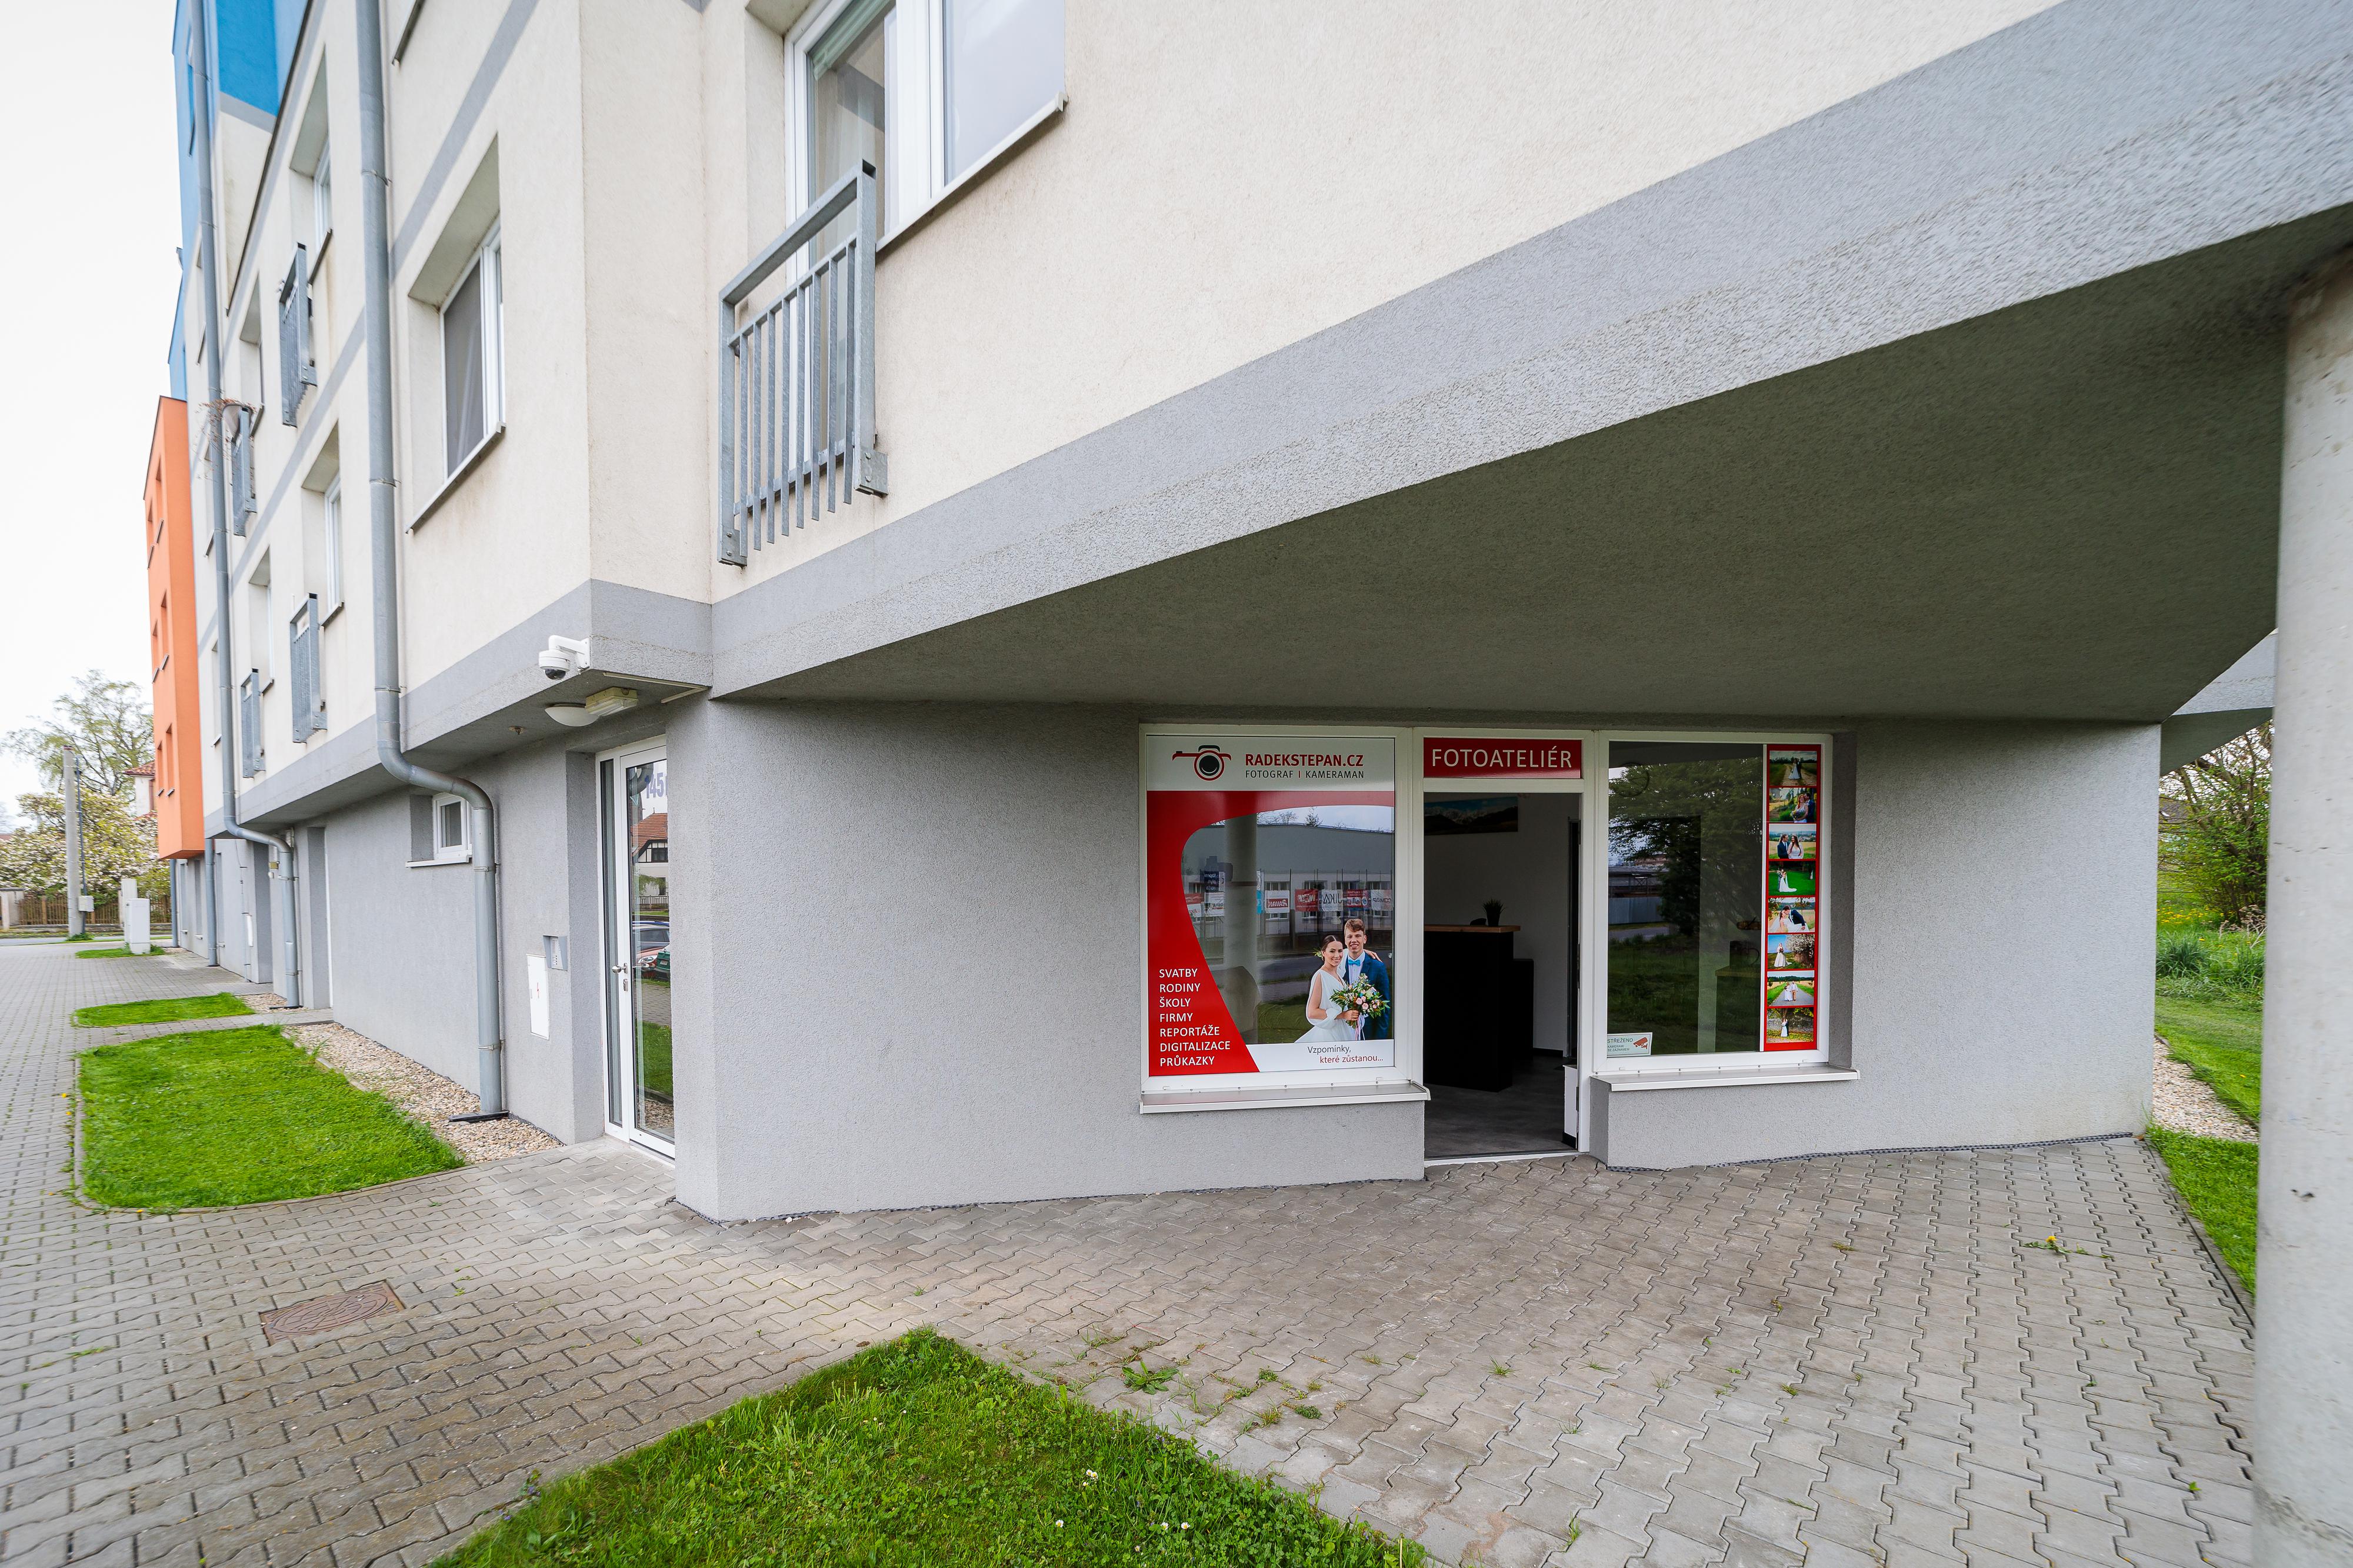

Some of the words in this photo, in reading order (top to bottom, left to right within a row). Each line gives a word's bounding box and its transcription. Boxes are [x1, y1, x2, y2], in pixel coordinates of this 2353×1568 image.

[1245, 753, 1364, 766] RADEKSTEPAN.CZ
[1432, 745, 1572, 768] FOTOATELIÉR
[1245, 770, 1294, 778] FOTOGRAF
[1305, 770, 1364, 779] KAMERAMAN
[1159, 968, 1198, 978] SVATBY
[1159, 983, 1201, 993] RODINY
[1159, 996, 1191, 1007] ŠKOLY
[1160, 1013, 1193, 1022] FIRMY
[1160, 1025, 1219, 1037] REPORTÁŽE
[1160, 1041, 1231, 1052] DIGITALIZACE
[1308, 1045, 1351, 1055] Vzpomínky,
[1160, 1055, 1215, 1067] PRŮKAZKY
[1320, 1055, 1339, 1063] které
